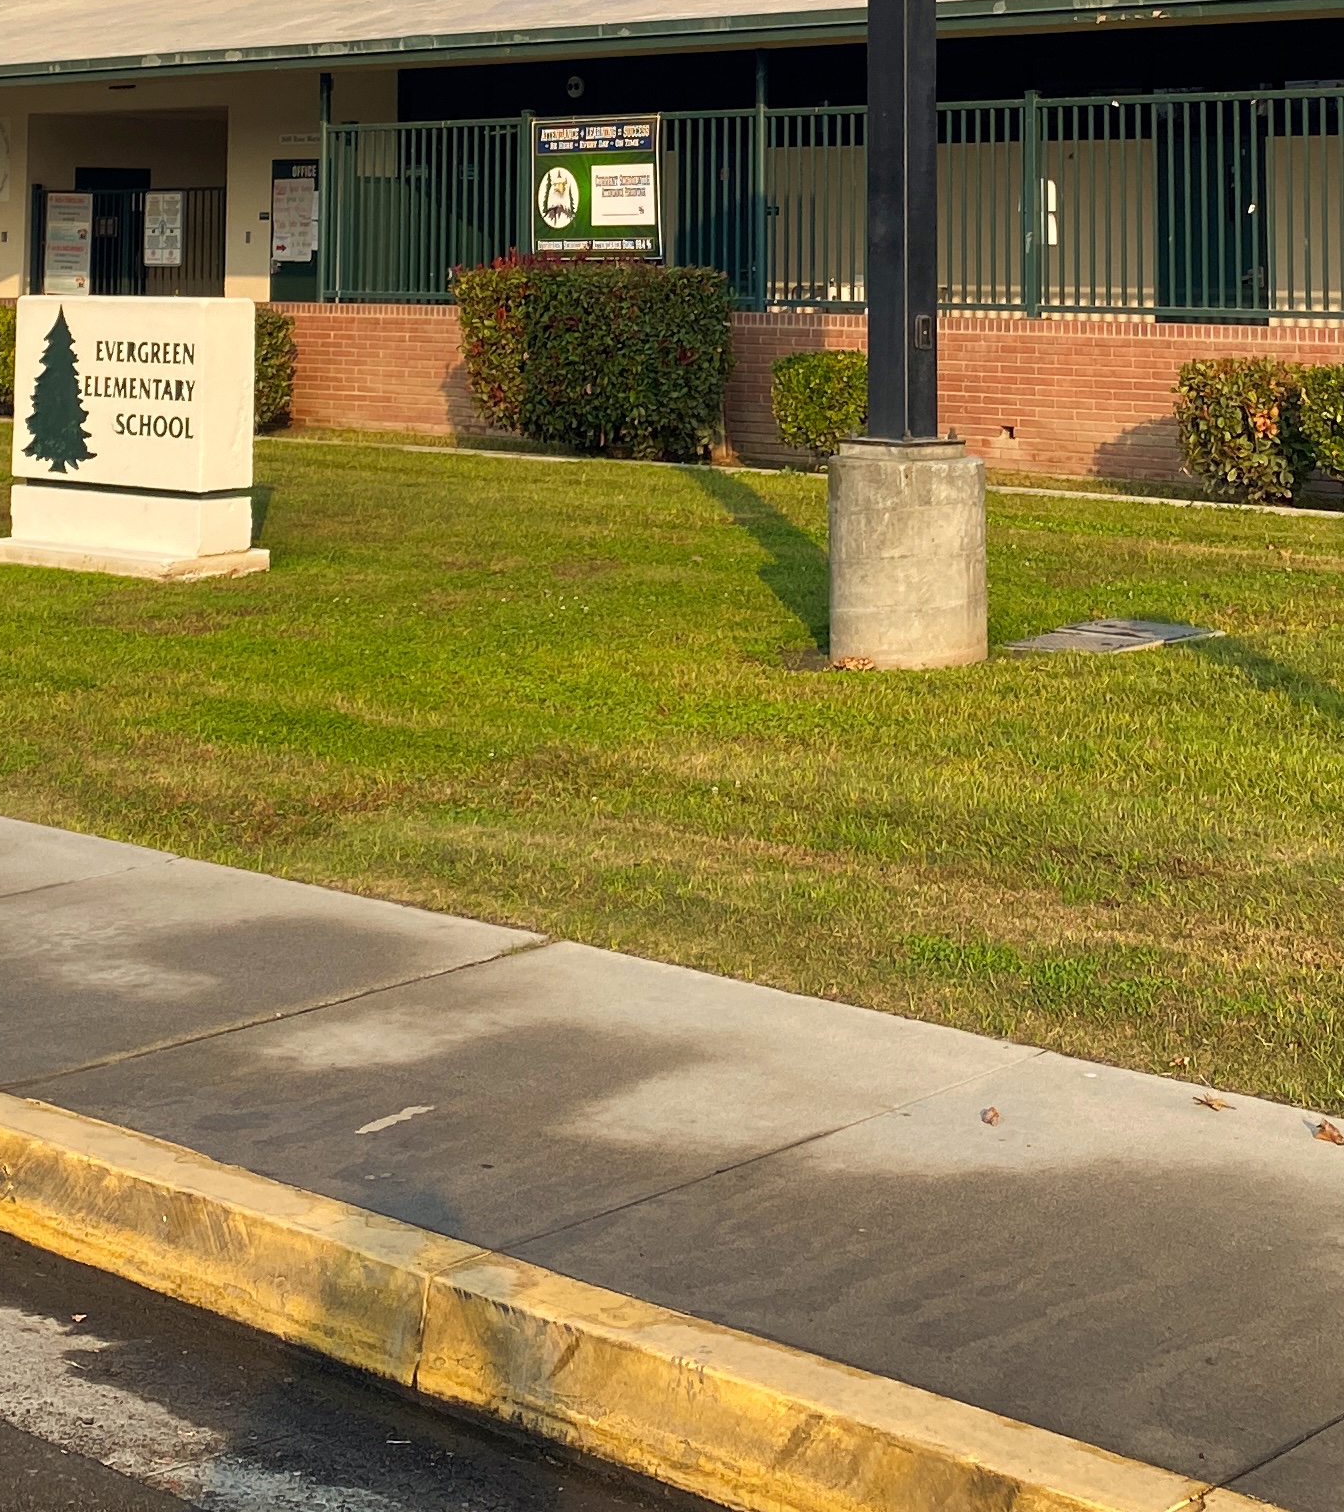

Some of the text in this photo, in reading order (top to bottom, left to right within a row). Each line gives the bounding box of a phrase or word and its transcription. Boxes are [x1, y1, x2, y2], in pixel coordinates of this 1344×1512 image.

[623, 124, 650, 137] SUCCESS
[291, 165, 317, 178] OFFICE
[95, 340, 196, 365] EVERGREEN
[83, 375, 196, 402] ELEMENTARY
[114, 412, 194, 439] SCHOOL
